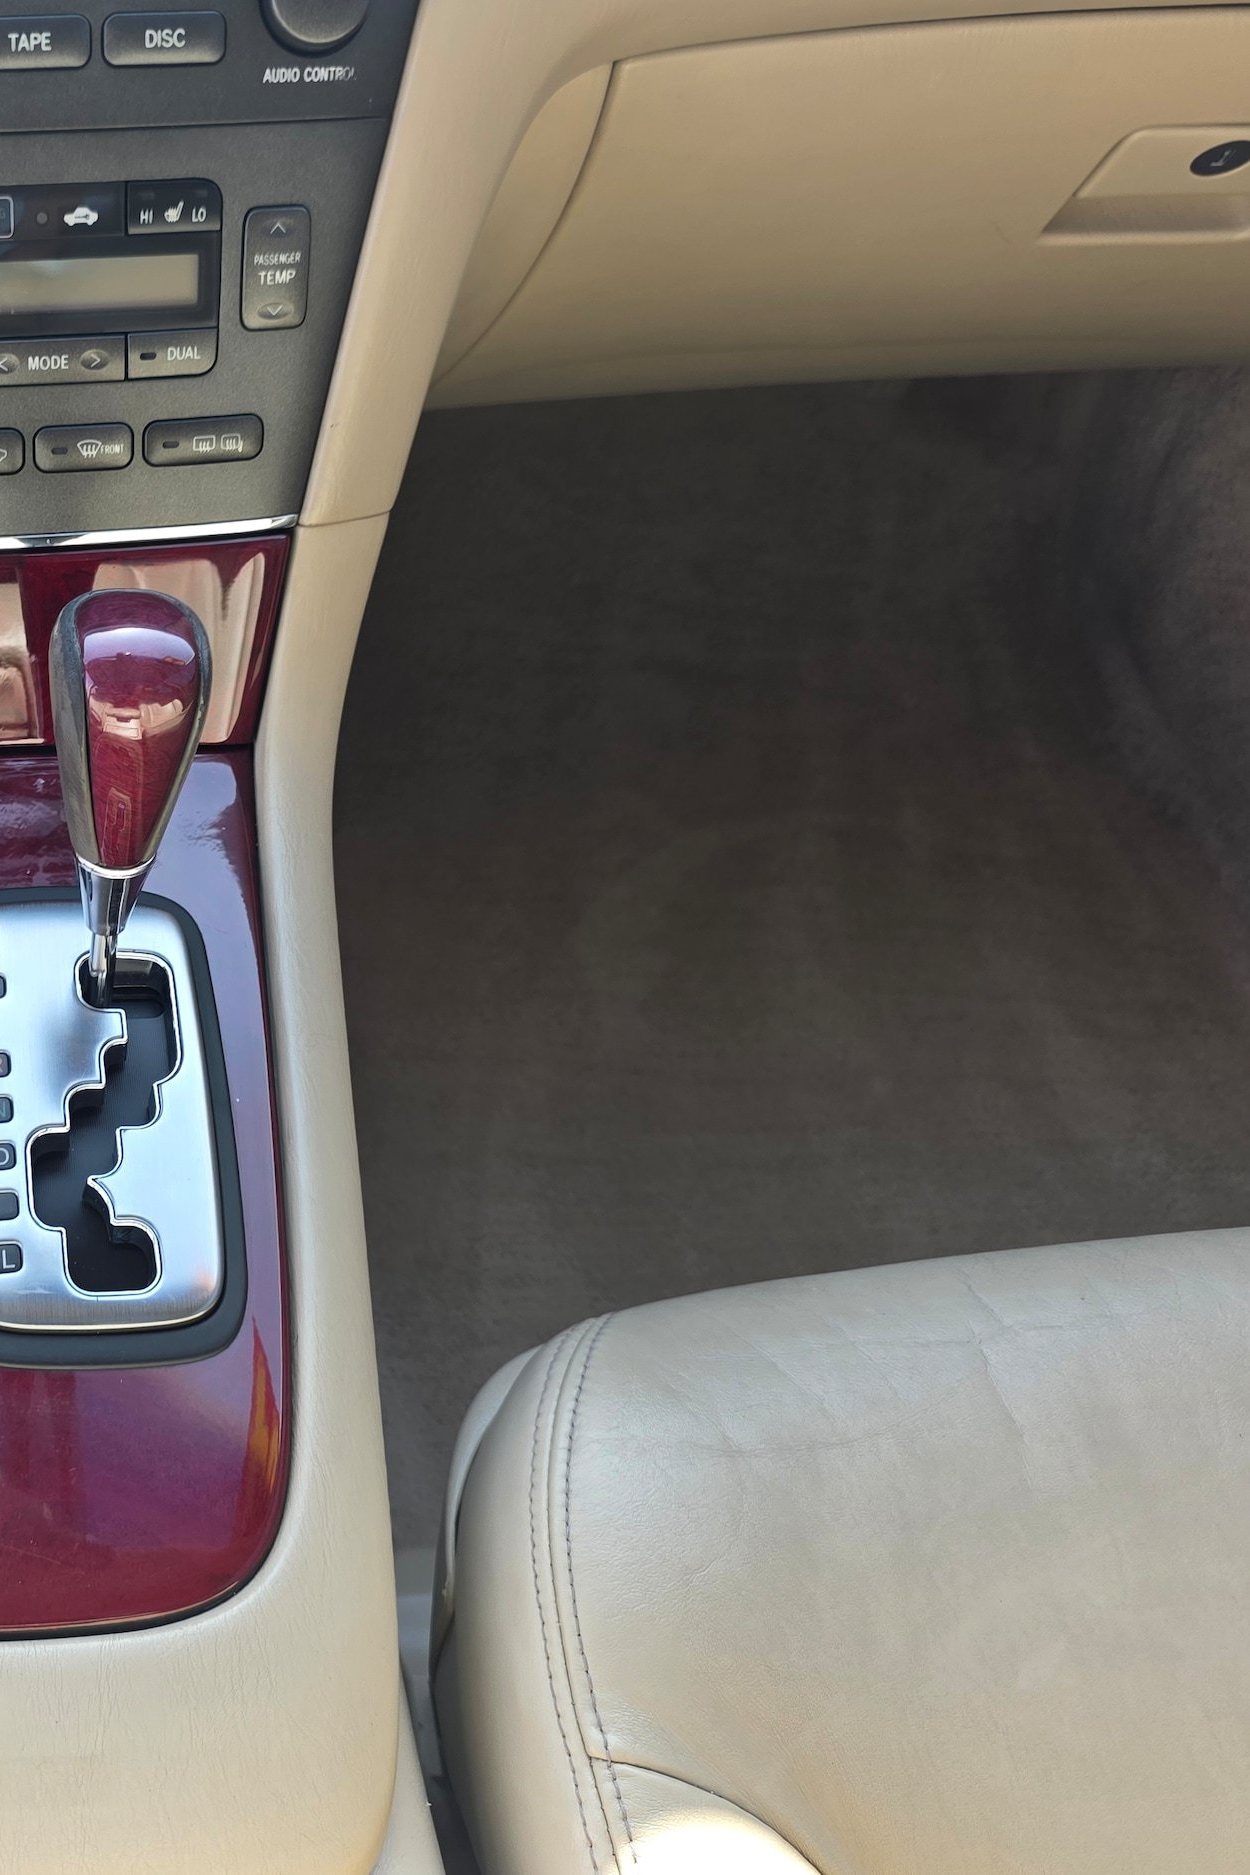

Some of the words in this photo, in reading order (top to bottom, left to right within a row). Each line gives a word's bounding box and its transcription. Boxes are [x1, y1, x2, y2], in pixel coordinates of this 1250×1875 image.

[8, 32, 52, 52] TAPE
[144, 28, 186, 50] DISC
[262, 67, 300, 83] AUDIO
[140, 208, 153, 224] HI
[191, 206, 207, 222] LO
[254, 251, 301, 266] PASSENGER
[258, 268, 296, 285] TEMP
[167, 346, 201, 361] DUAL
[27, 355, 69, 370] MODE
[100, 444, 124, 455] FRONT
